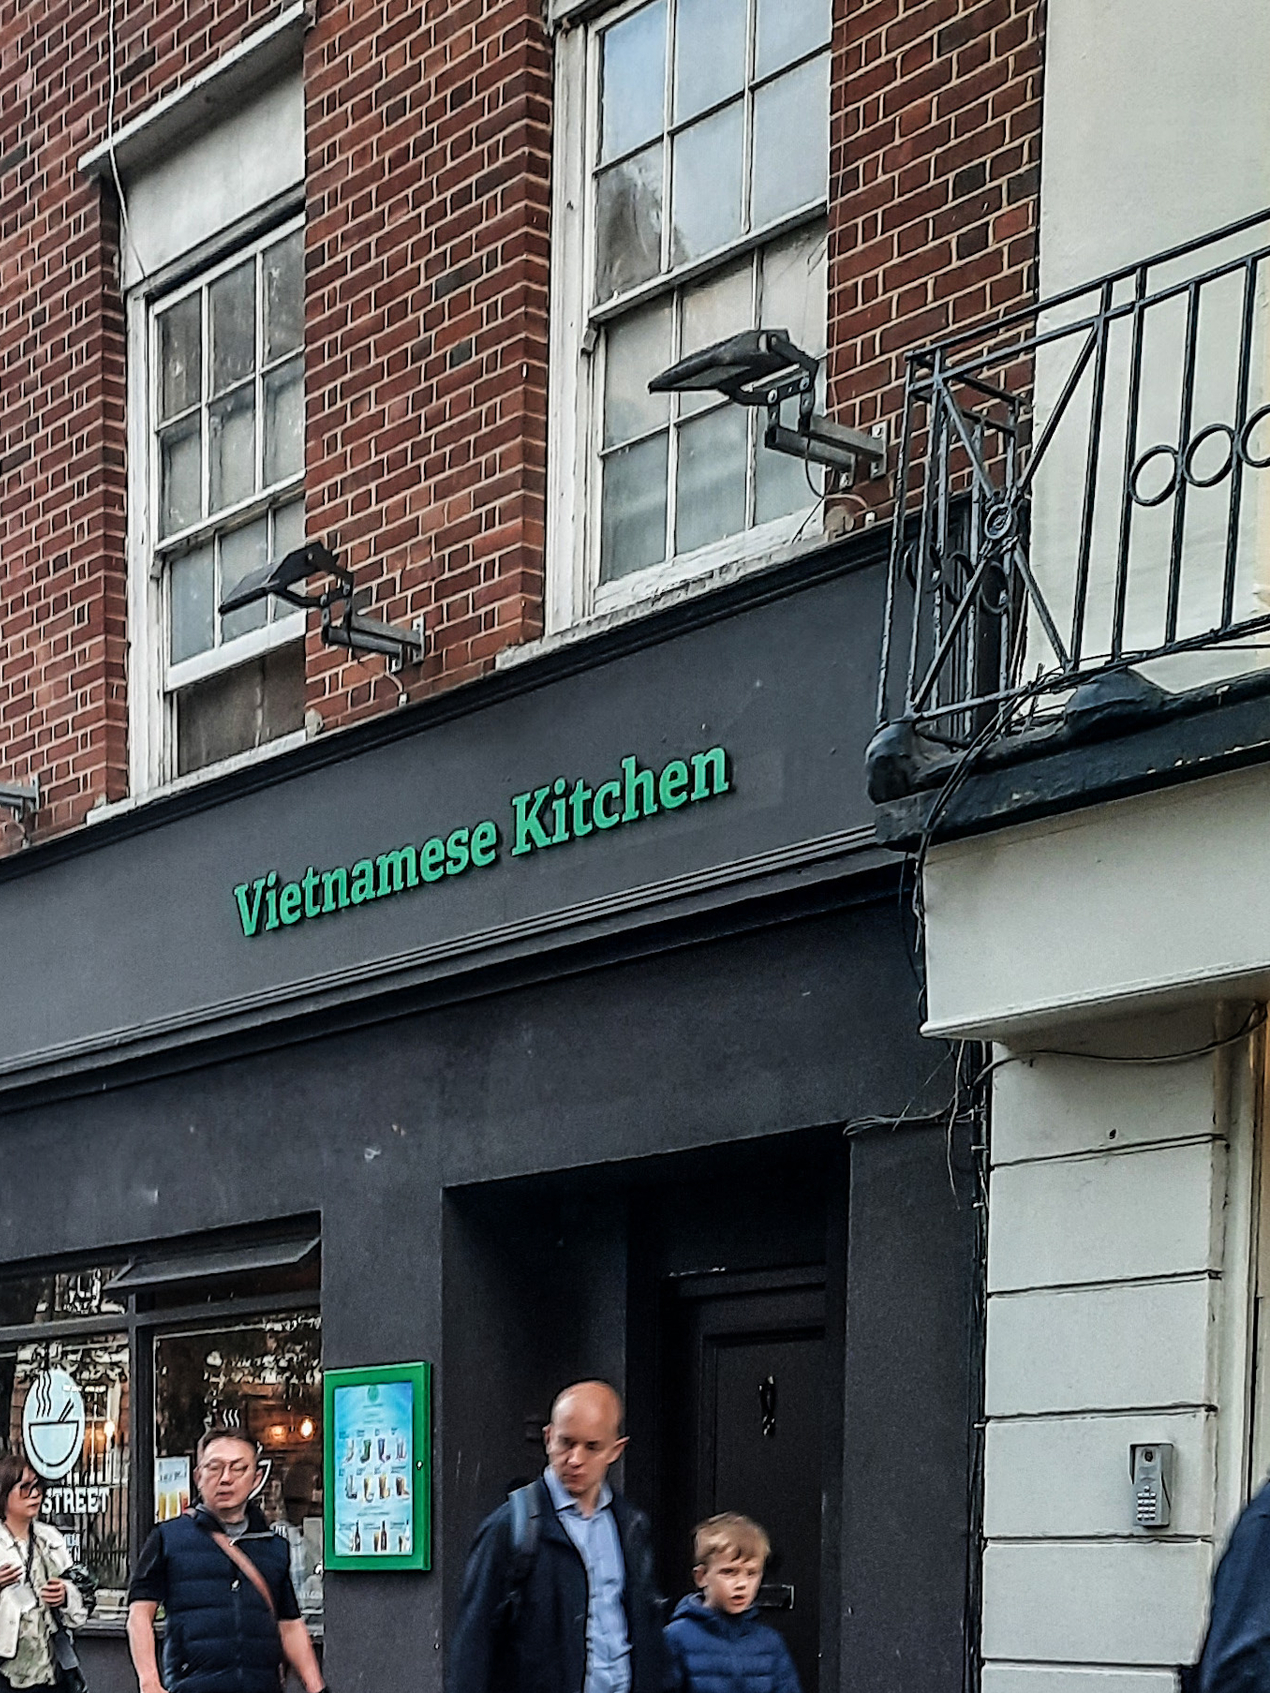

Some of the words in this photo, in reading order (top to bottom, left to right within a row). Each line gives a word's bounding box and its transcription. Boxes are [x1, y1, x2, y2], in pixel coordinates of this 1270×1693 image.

[233, 820, 498, 937] Vietnamese
[511, 745, 729, 856] Kitchen
[42, 1487, 110, 1515] STREET
